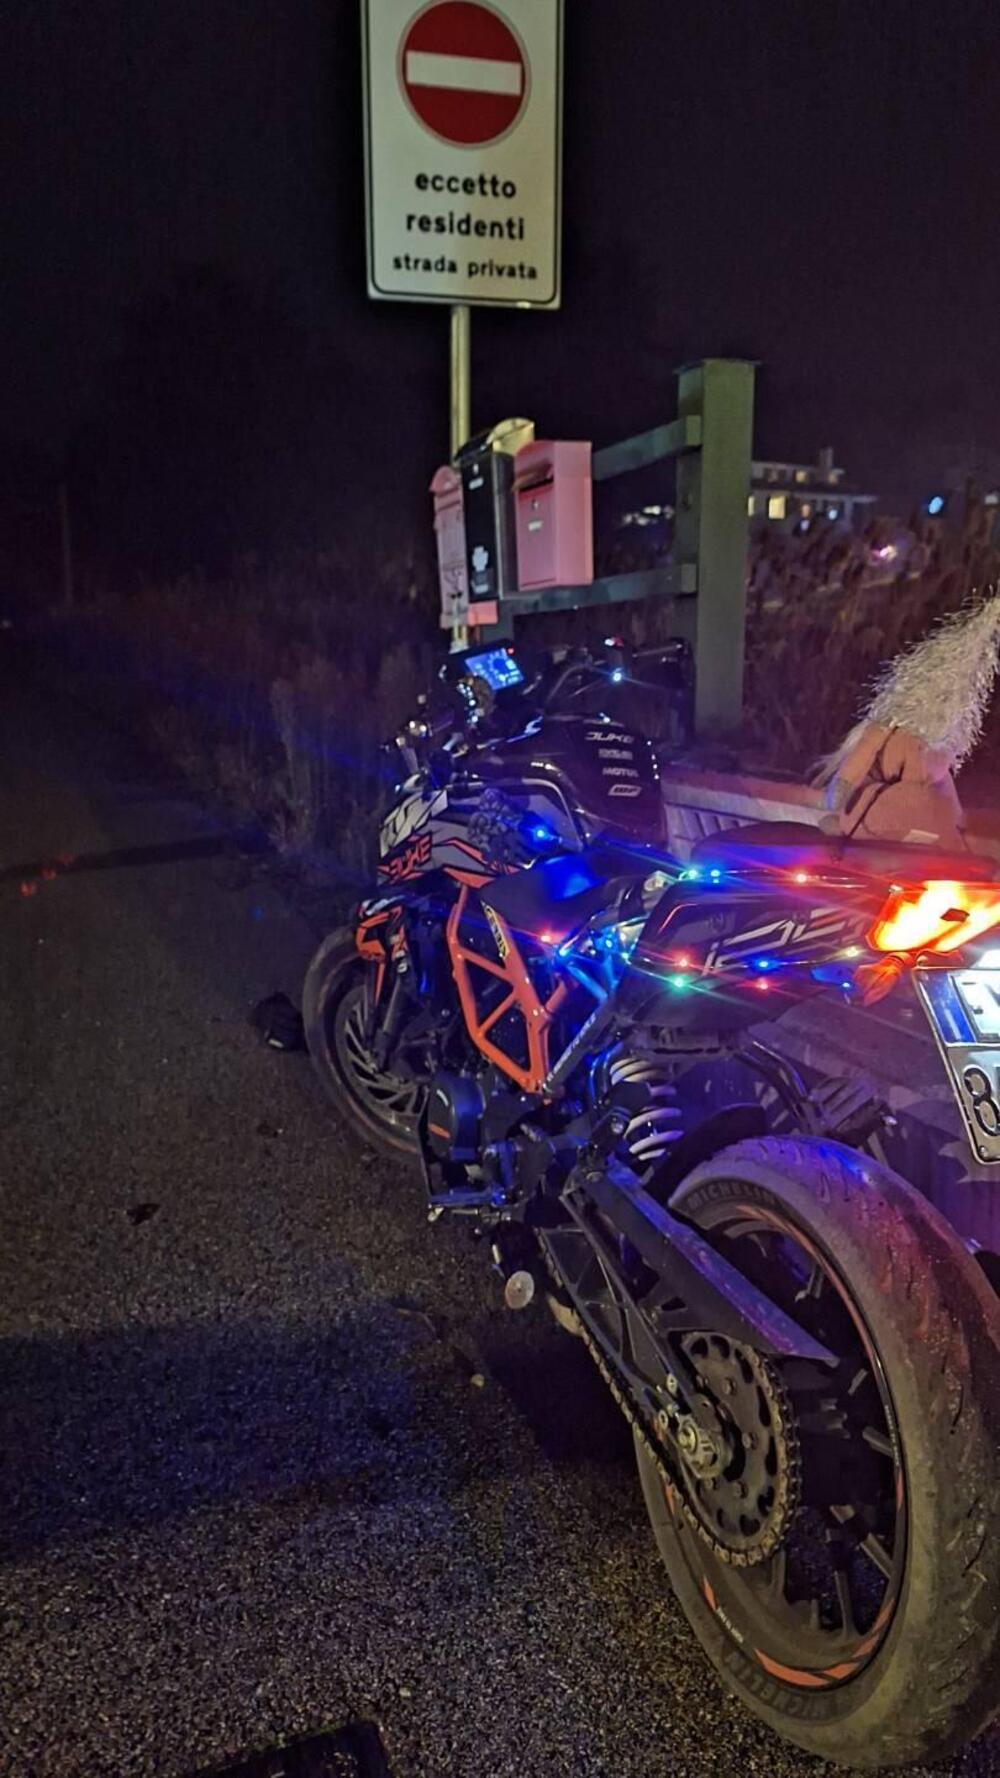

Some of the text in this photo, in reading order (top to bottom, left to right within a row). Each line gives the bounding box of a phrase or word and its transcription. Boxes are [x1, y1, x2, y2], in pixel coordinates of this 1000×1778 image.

[415, 172, 517, 199] eccetto
[406, 211, 525, 241] residenti
[393, 254, 538, 280] strada privata
